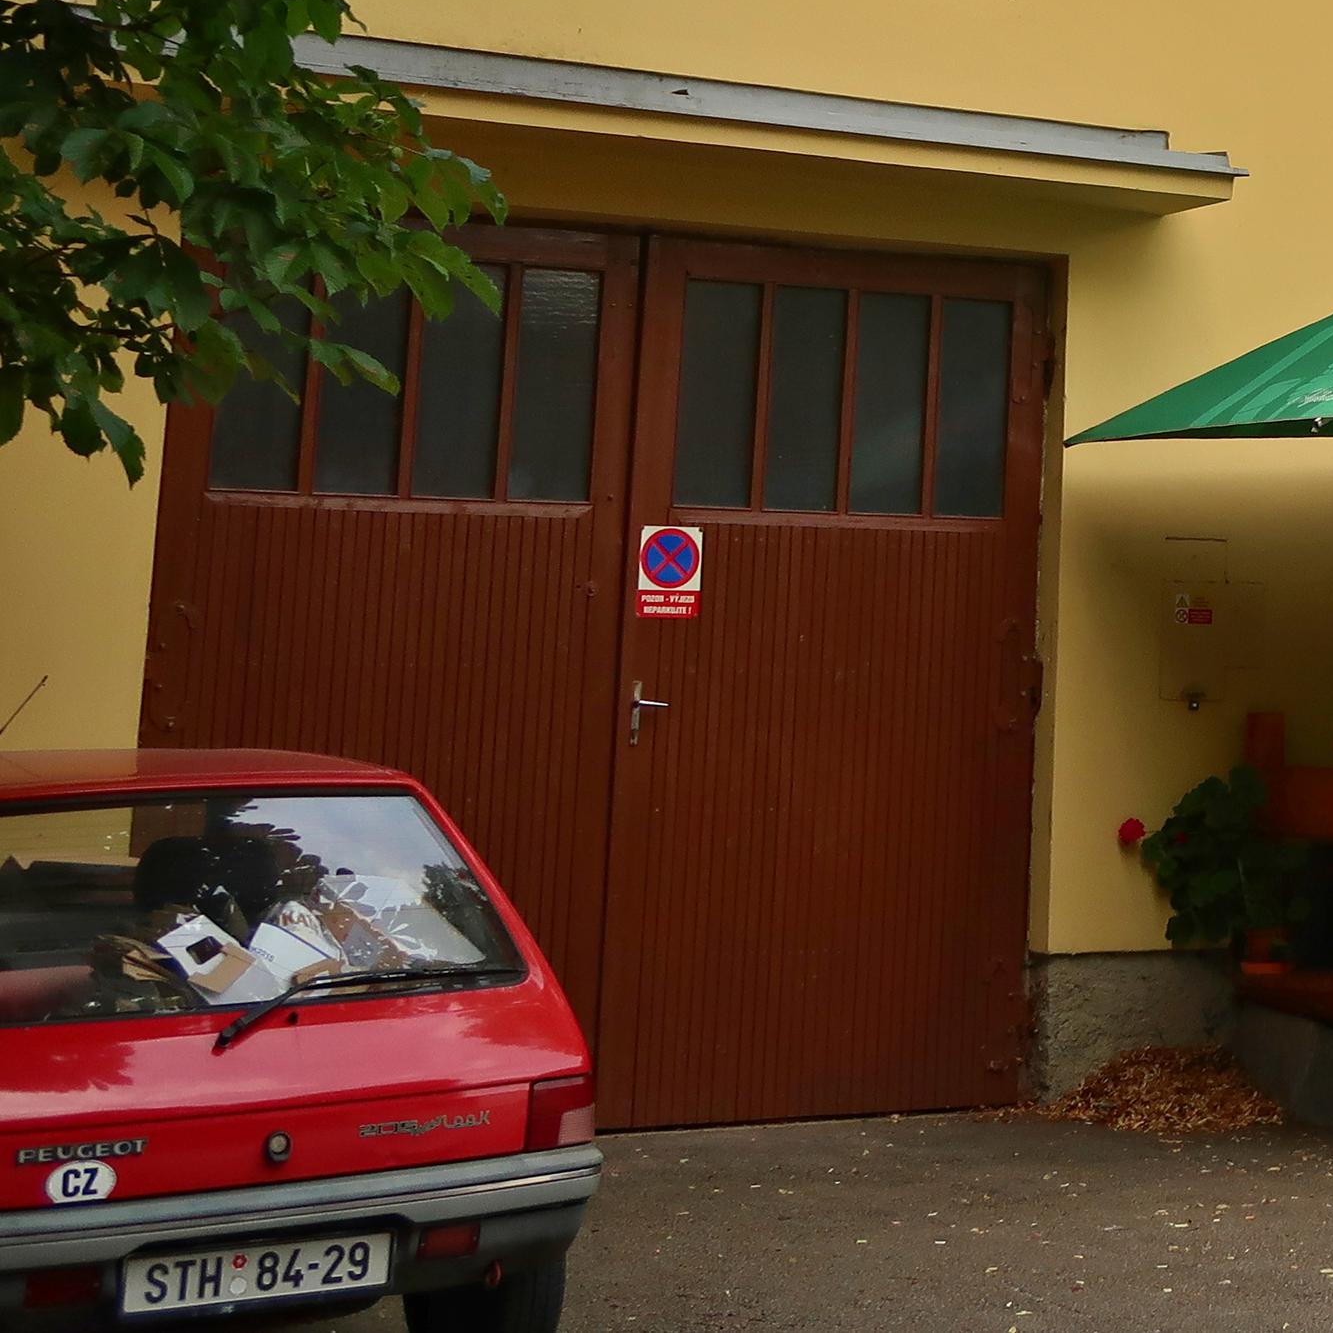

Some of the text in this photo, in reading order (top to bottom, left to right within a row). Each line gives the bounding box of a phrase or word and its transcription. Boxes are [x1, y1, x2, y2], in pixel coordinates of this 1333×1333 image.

[18, 1138, 147, 1164] PEUGEOT
[61, 1167, 99, 1198] CZ
[144, 1241, 371, 1305] STH 84-29
